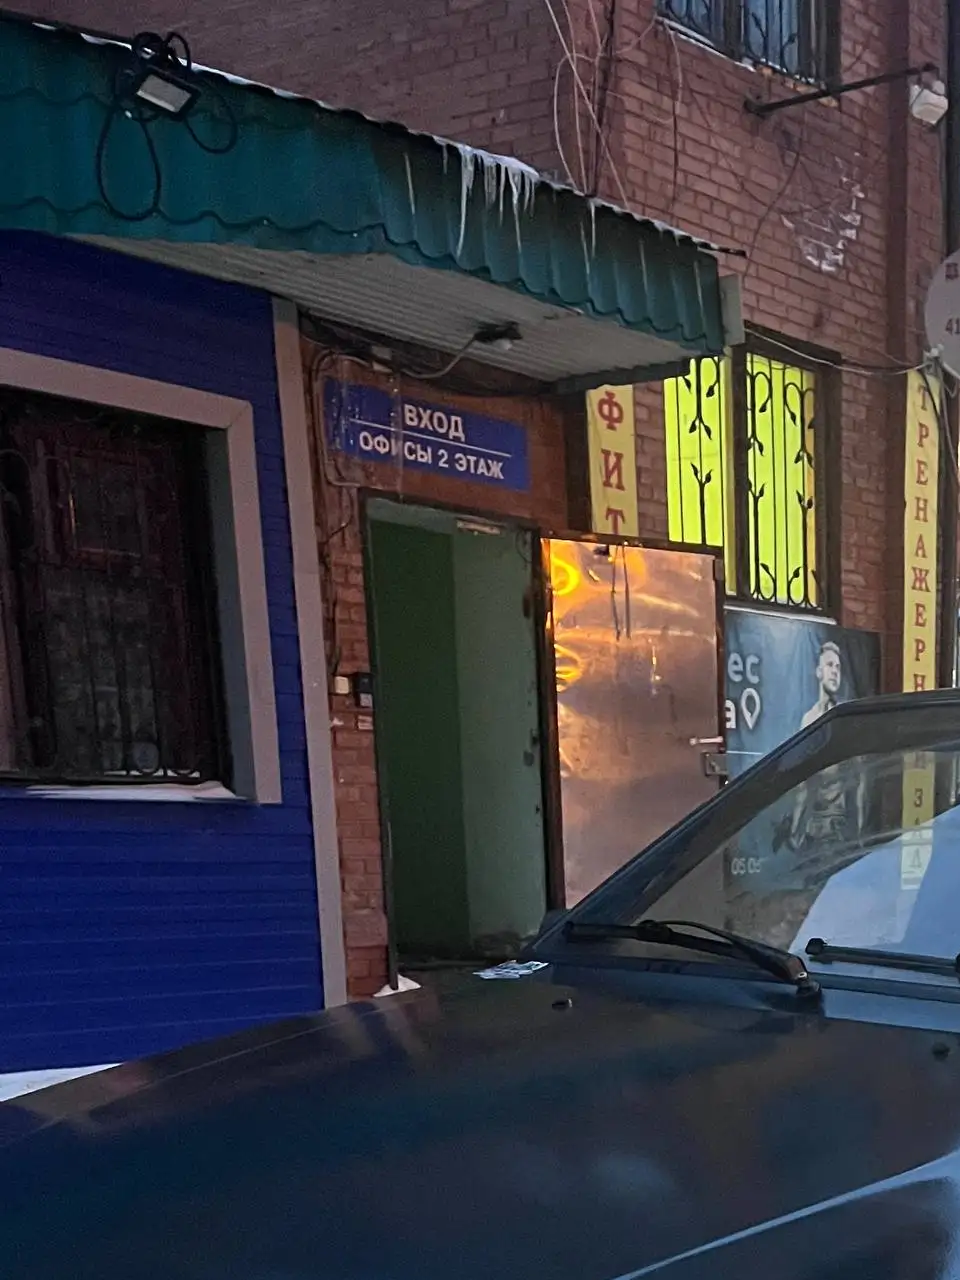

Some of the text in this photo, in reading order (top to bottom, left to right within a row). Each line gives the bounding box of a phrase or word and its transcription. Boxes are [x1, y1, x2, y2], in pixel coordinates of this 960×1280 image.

[403, 403, 466, 442] ВХОД
[358, 430, 505, 480] ОФИСЫ 2 ЭТАЖ
